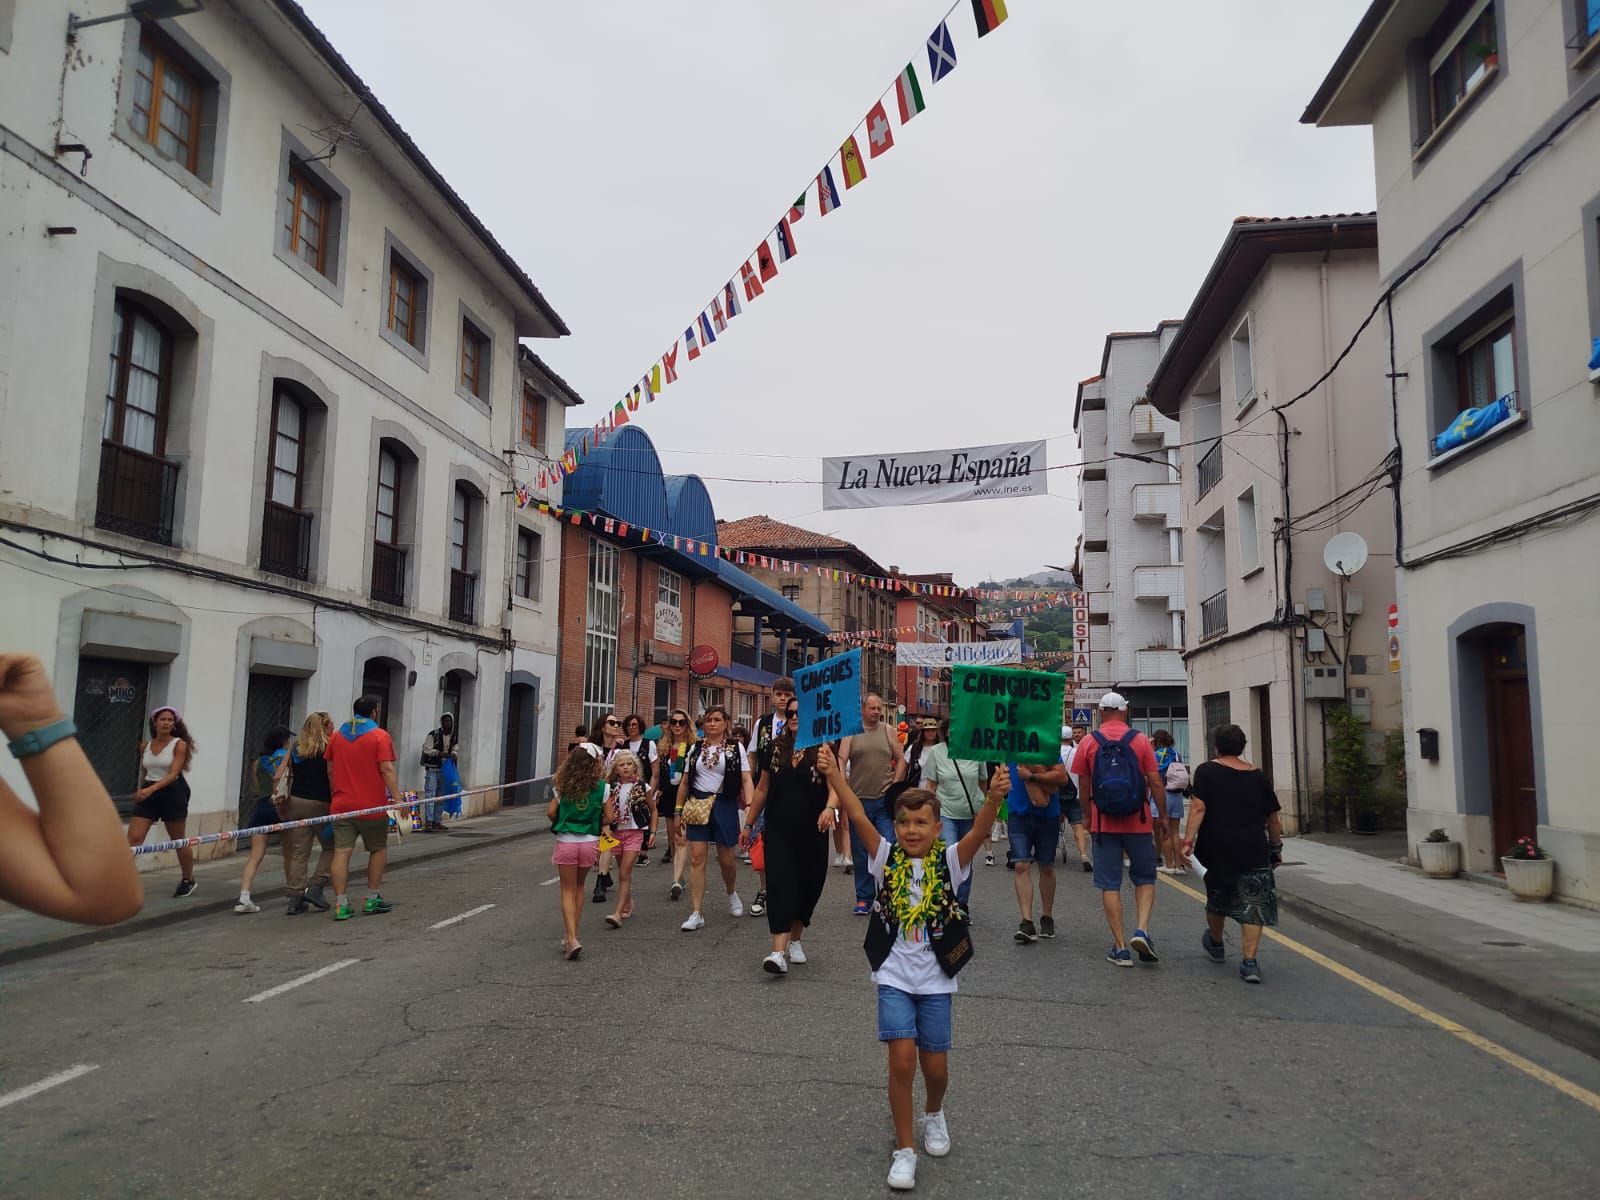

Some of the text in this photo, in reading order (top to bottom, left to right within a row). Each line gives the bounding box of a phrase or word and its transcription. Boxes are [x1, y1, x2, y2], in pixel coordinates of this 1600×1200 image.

[838, 451, 1032, 490] La Nueva España
[973, 484, 1033, 496] www.lne.es
[1075, 594, 1087, 682] HOSTAL
[800, 657, 854, 694] CANGUES
[962, 672, 1052, 702] CANGUES
[816, 689, 833, 712] DE
[994, 702, 1020, 726] DE
[969, 727, 1041, 753] ARRIBA
